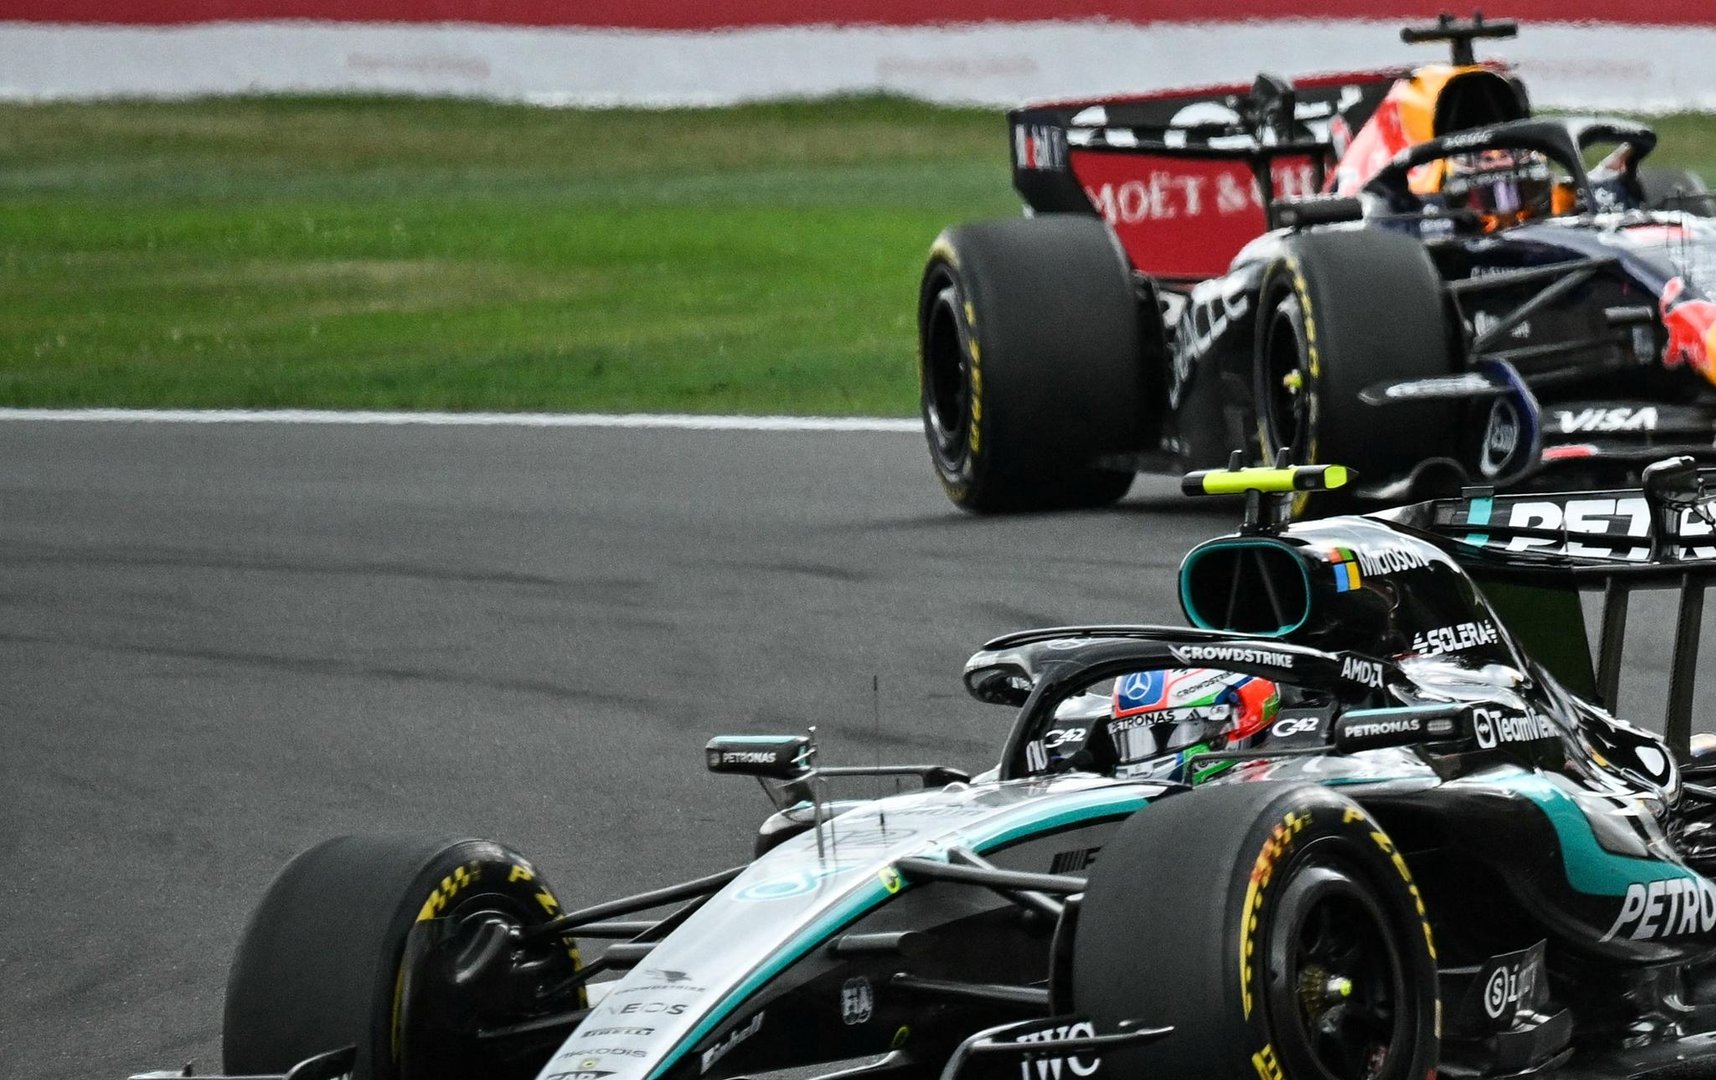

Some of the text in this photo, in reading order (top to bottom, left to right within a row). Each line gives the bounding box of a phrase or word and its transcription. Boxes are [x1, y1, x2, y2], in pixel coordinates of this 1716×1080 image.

[1554, 406, 1658, 434] VISA
[1426, 621, 1489, 655] SOLERA
[1178, 645, 1294, 669] CROWDSTRIKE
[1341, 656, 1373, 685] AMD
[1272, 716, 1319, 739] G42
[1344, 719, 1421, 738] PETRONAS
[721, 752, 777, 764] PETRONAS
